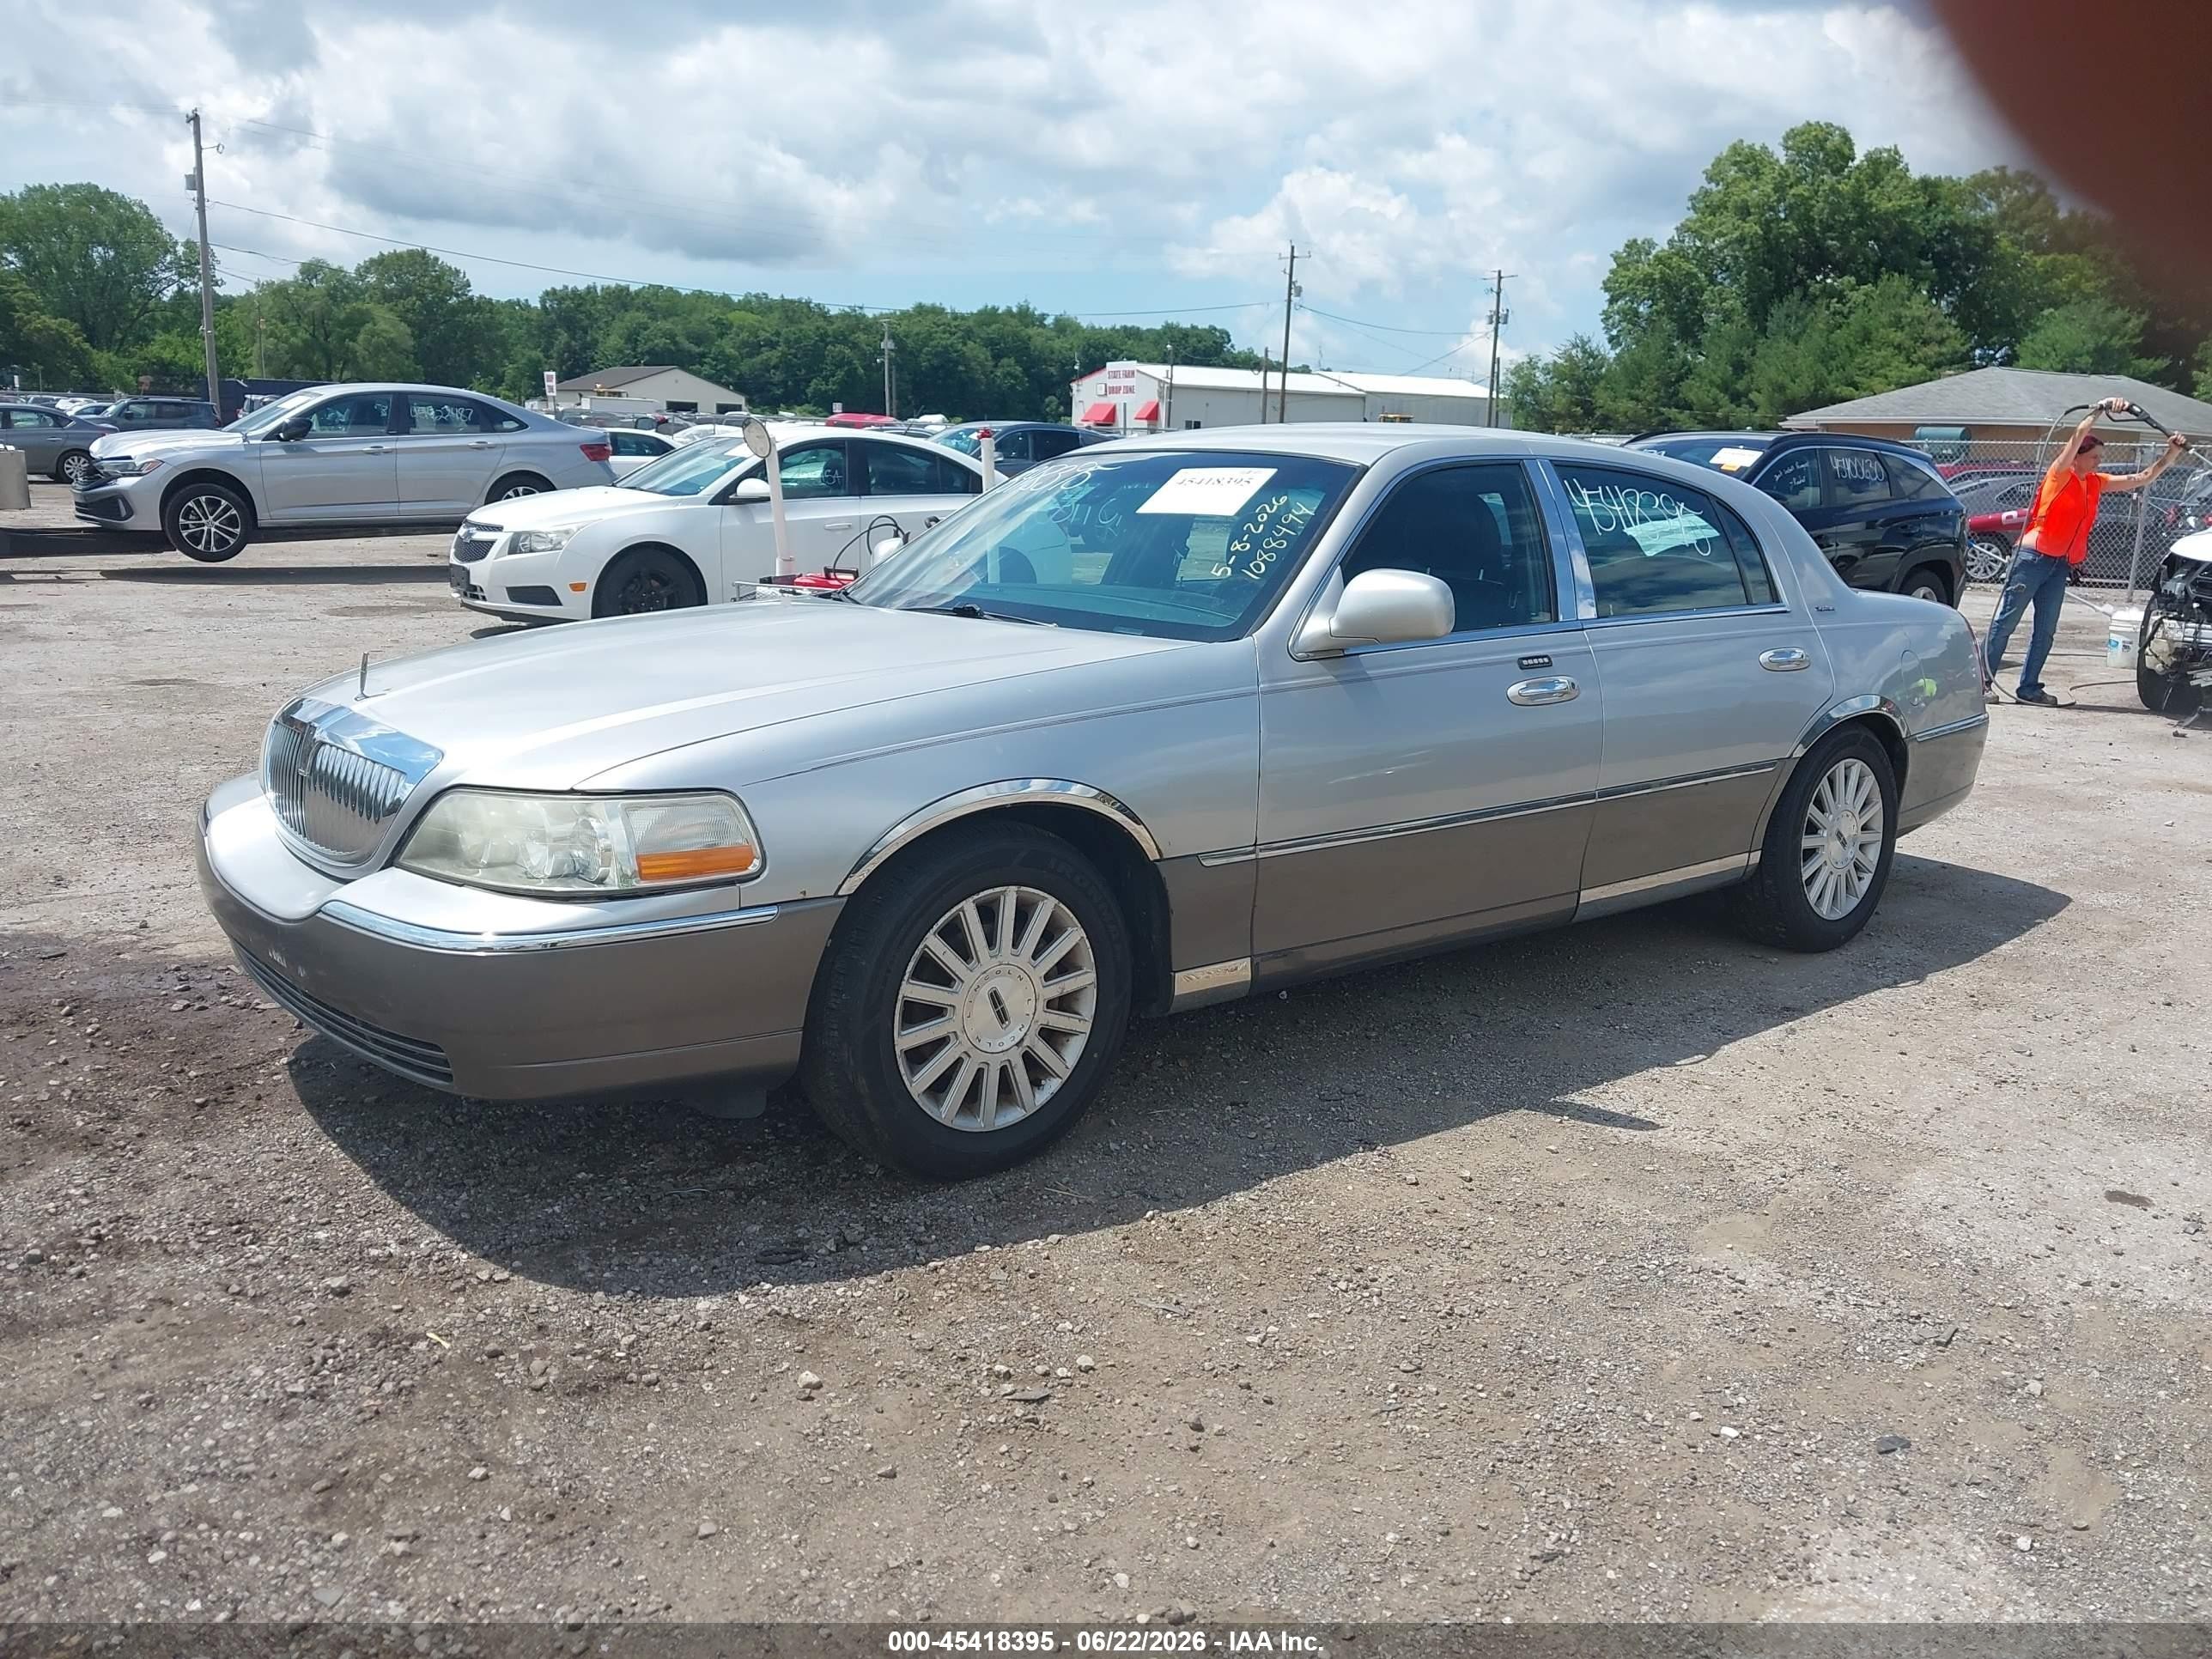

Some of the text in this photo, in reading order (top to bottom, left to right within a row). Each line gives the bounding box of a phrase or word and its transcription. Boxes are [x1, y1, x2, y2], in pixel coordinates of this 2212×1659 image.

[1108, 369, 1135, 379] STATE FARM
[1108, 385, 1135, 394] DROP ZONE
[1211, 495, 1288, 577] 5-8-2026
[1241, 501, 1316, 580] 1088494
[966, 969, 1024, 1018] LINCOLN
[975, 998, 1032, 1048] LINCOLN
